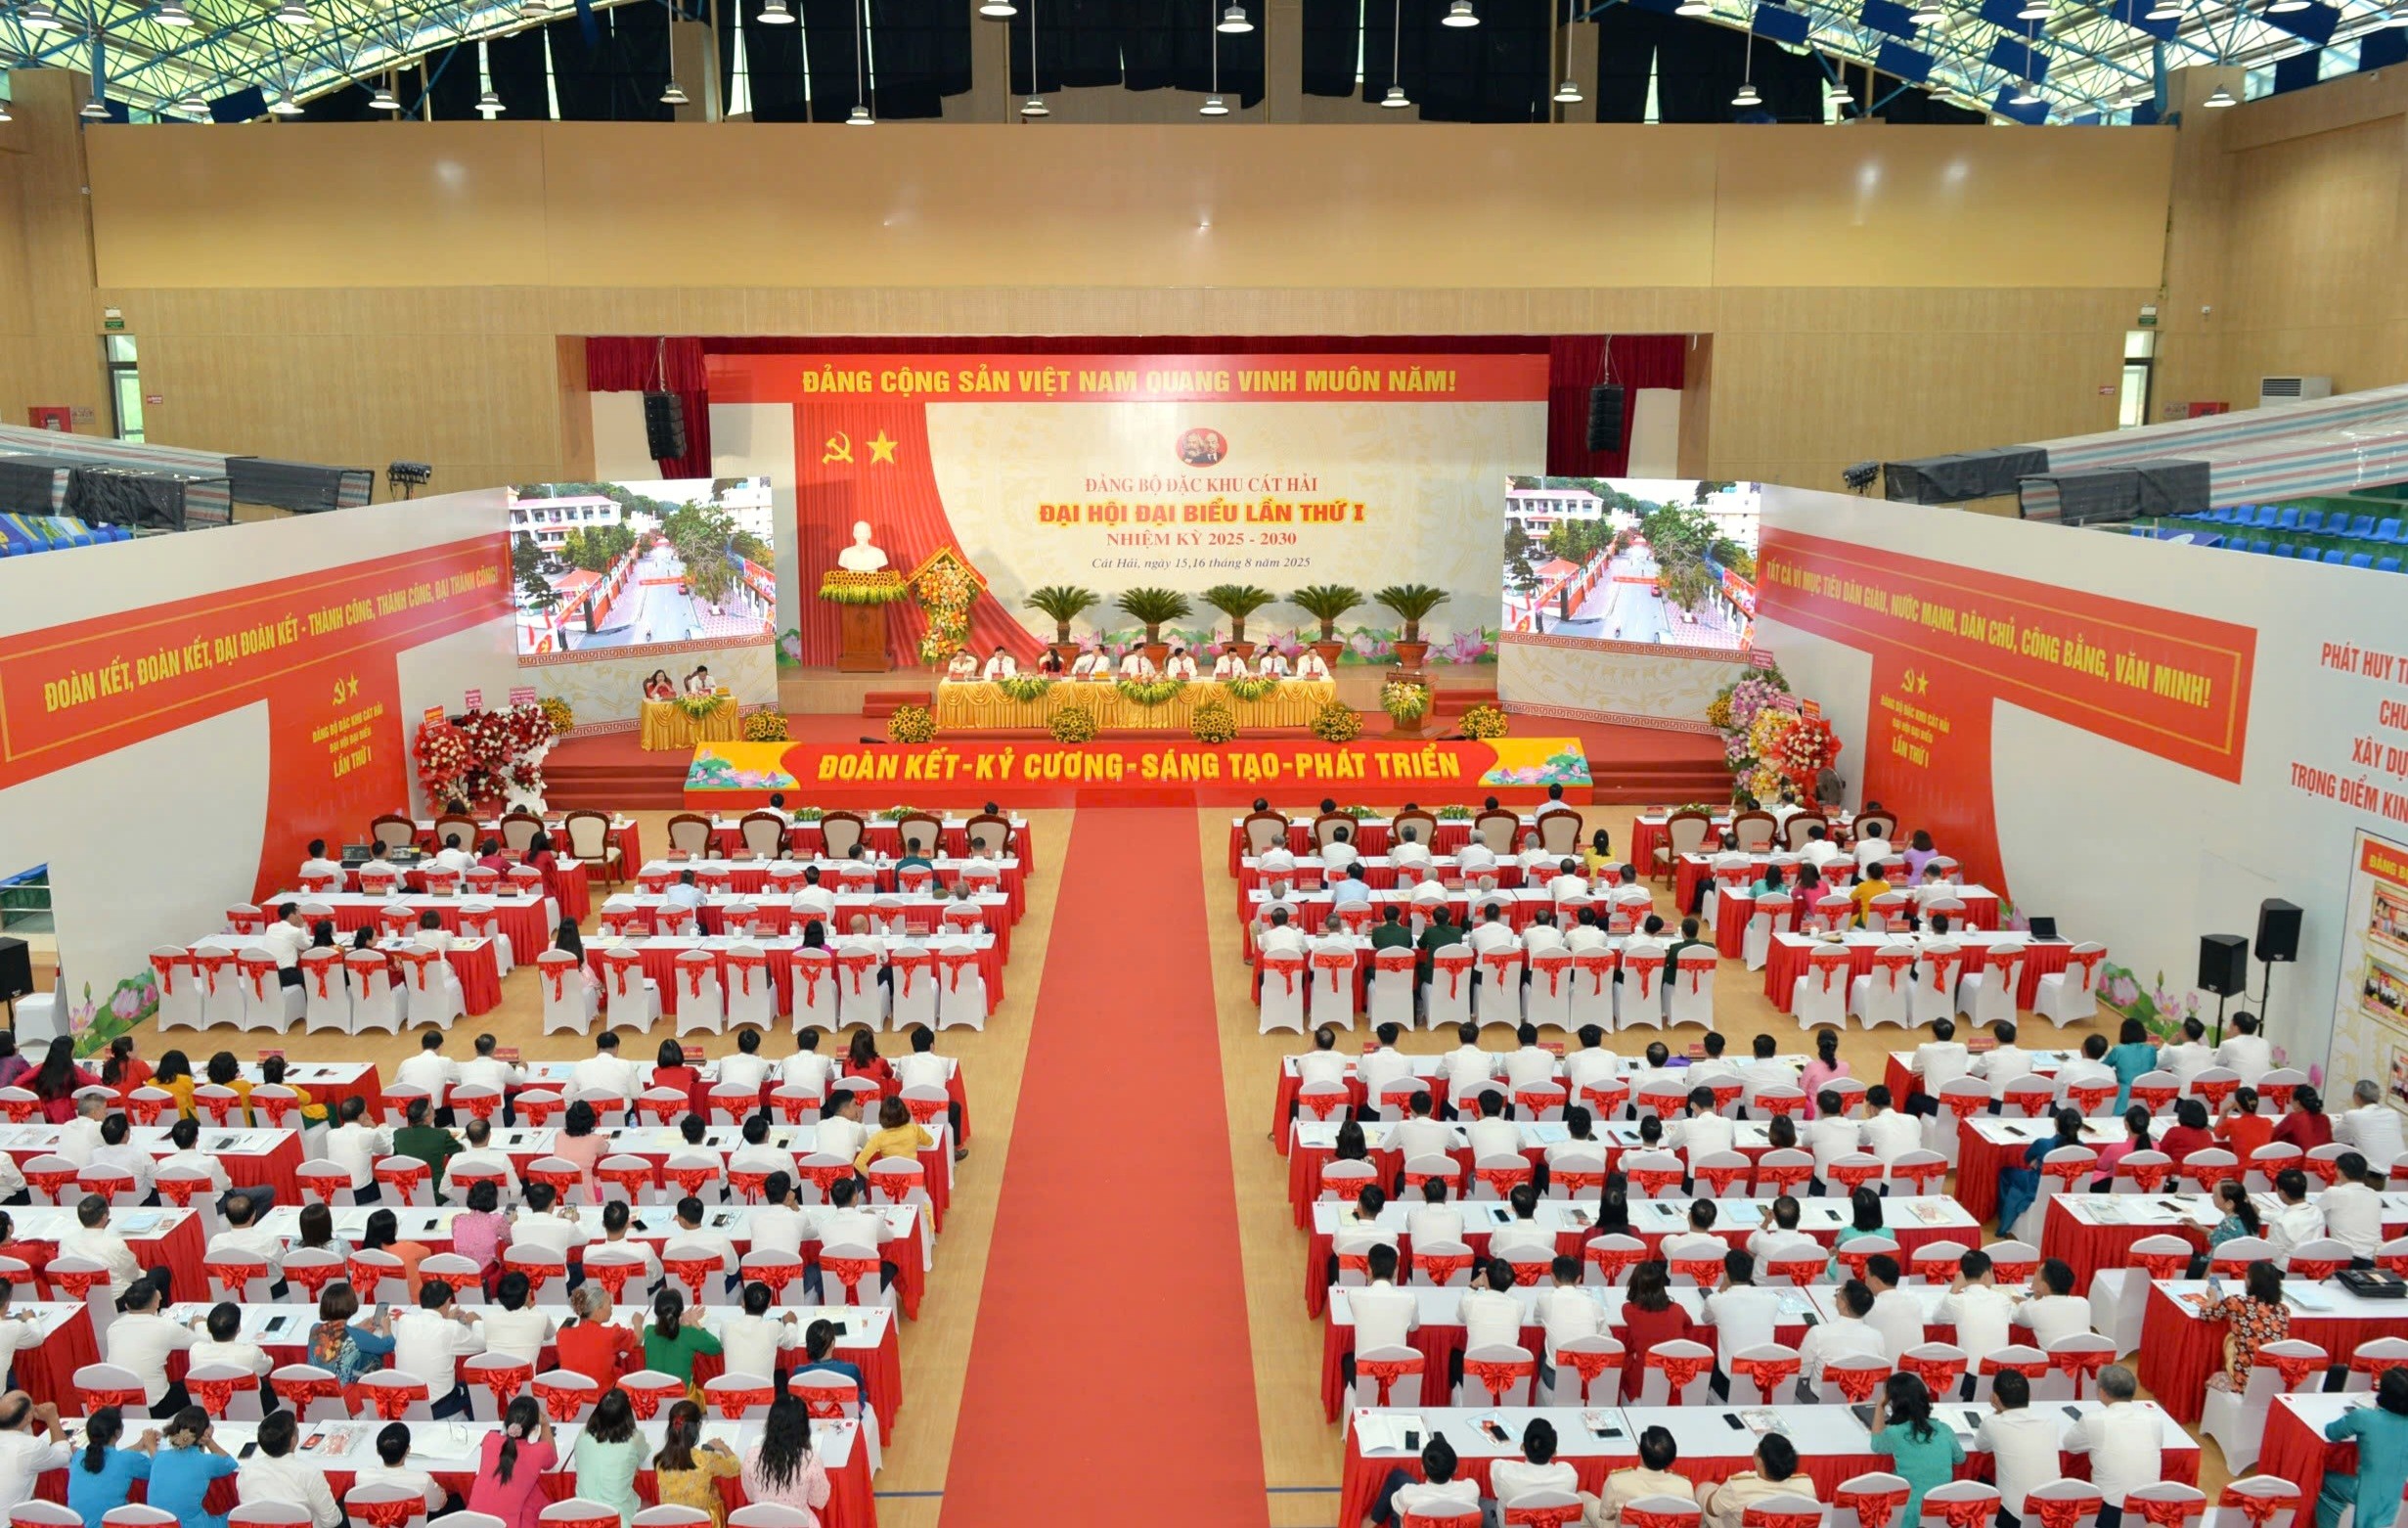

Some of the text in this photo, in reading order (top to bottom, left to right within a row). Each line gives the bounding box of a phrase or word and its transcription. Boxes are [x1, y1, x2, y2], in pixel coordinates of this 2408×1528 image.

[803, 363, 1456, 397] ĐẢNG CỘNG SẢN VIỆT NAM QUANG VINH MUÔN NĂM!
[1086, 472, 1318, 495] ĐẢNG BỘ ĐẶC KHU CÁT HẢI
[1040, 497, 1365, 526] ĐẠI HỘI ĐẠI BIỂU LẦN THỨ I
[1106, 530, 1170, 549] NHIỆM
[1177, 528, 1203, 546] KỲ
[1208, 532, 1245, 546] 2025
[1260, 532, 1297, 546] 2030
[1092, 558, 1113, 568] Cát
[1144, 558, 1172, 570] ngày
[1209, 557, 1242, 570] tháng
[1244, 558, 1252, 568] 8
[1255, 559, 1280, 568] năm
[1284, 558, 1311, 568] 2025
[45, 670, 96, 713] ĐOÀN
[99, 654, 134, 697] KẾT,
[137, 648, 181, 686] ĐOÀN
[184, 634, 212, 672] KẾT,
[214, 634, 238, 666] ĐẠI
[241, 622, 276, 657] ĐOÀN
[277, 612, 298, 646] KẾT
[308, 606, 343, 637] THÀNH
[345, 598, 376, 625] CÔNG,
[377, 588, 407, 615] THÀNH
[408, 582, 434, 607] CÔNG,
[435, 579, 450, 603] ĐẠI
[450, 569, 476, 595] THÀNH
[1766, 557, 2212, 709] TẤT CẢ VÌ MỤC TIÊU DÂN GIÀU, NƯỚC MẠNH, DÂN CHỦ, CÔNG BẰNG, VĂN MINH!
[2321, 641, 2360, 673] PHÁT
[2362, 651, 2394, 680] HUY
[333, 752, 350, 779] LẦN
[351, 744, 367, 770] THỨ
[819, 749, 899, 782] ĐOÀN
[1374, 743, 1461, 780] TRIỂN
[1893, 734, 1908, 758] LẦN
[1909, 743, 1926, 766] THỨ
[2351, 736, 2384, 769] XÂY
[2291, 762, 2336, 797] TRỌNG
[2340, 774, 2379, 813] ĐIỂM
